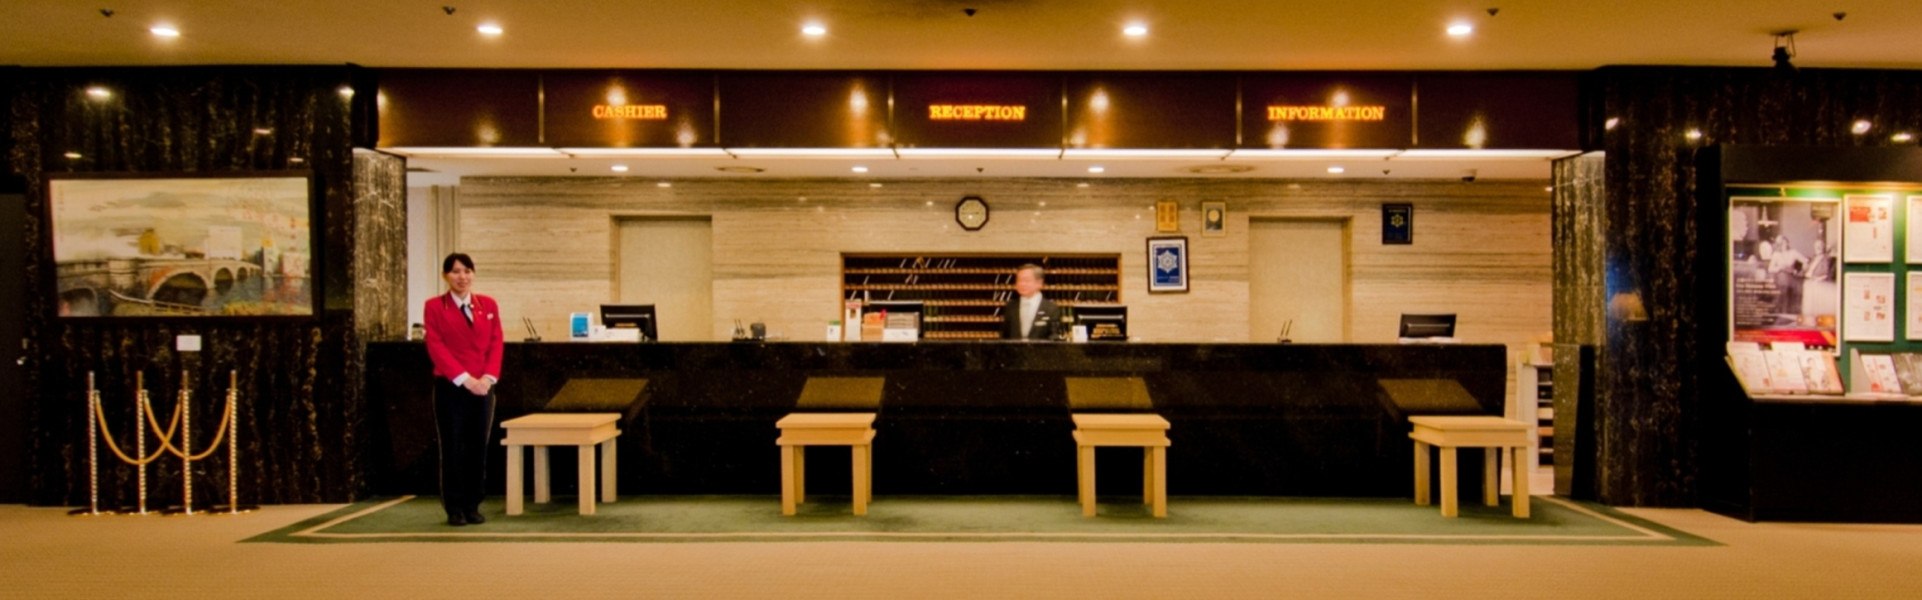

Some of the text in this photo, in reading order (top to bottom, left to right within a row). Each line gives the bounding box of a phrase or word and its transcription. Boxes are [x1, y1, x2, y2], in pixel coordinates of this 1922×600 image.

[592, 104, 668, 119] CASHIER
[929, 105, 1025, 120] RECEPTION
[1267, 105, 1385, 121] INFORMATION
